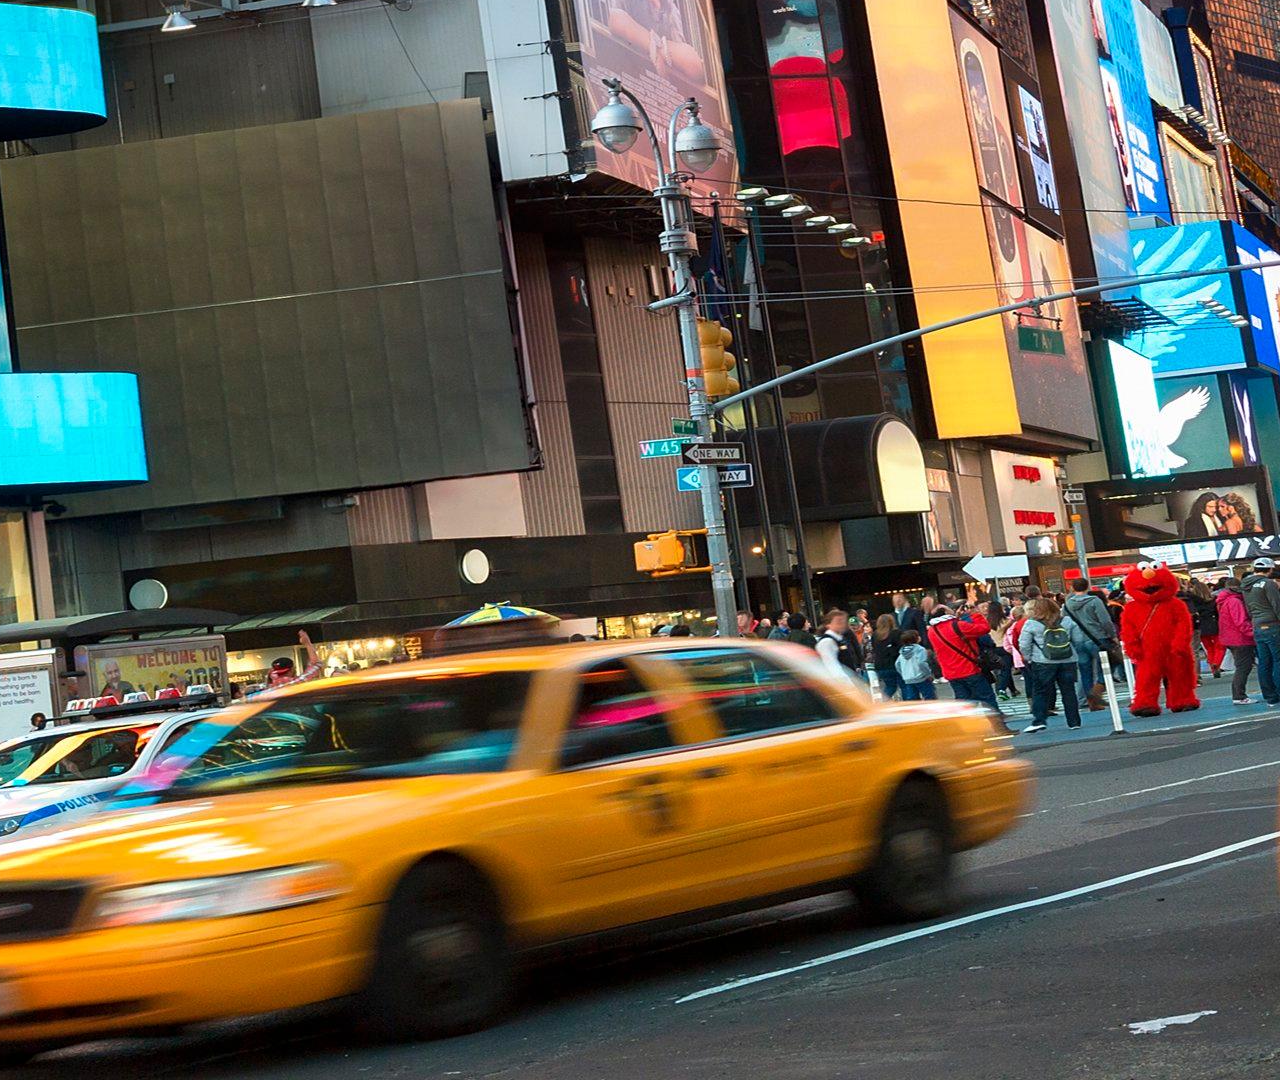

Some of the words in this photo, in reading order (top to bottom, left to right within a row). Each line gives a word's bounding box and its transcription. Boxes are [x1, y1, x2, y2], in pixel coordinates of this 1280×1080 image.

[1033, 332, 1039, 349] 7
[640, 443, 655, 456] W
[660, 441, 679, 454] 45
[692, 448, 712, 458] ONE
[716, 449, 736, 459] WAY
[720, 471, 741, 481] WAY
[137, 650, 197, 669] WELCOME
[59, 793, 99, 812] POLICE
